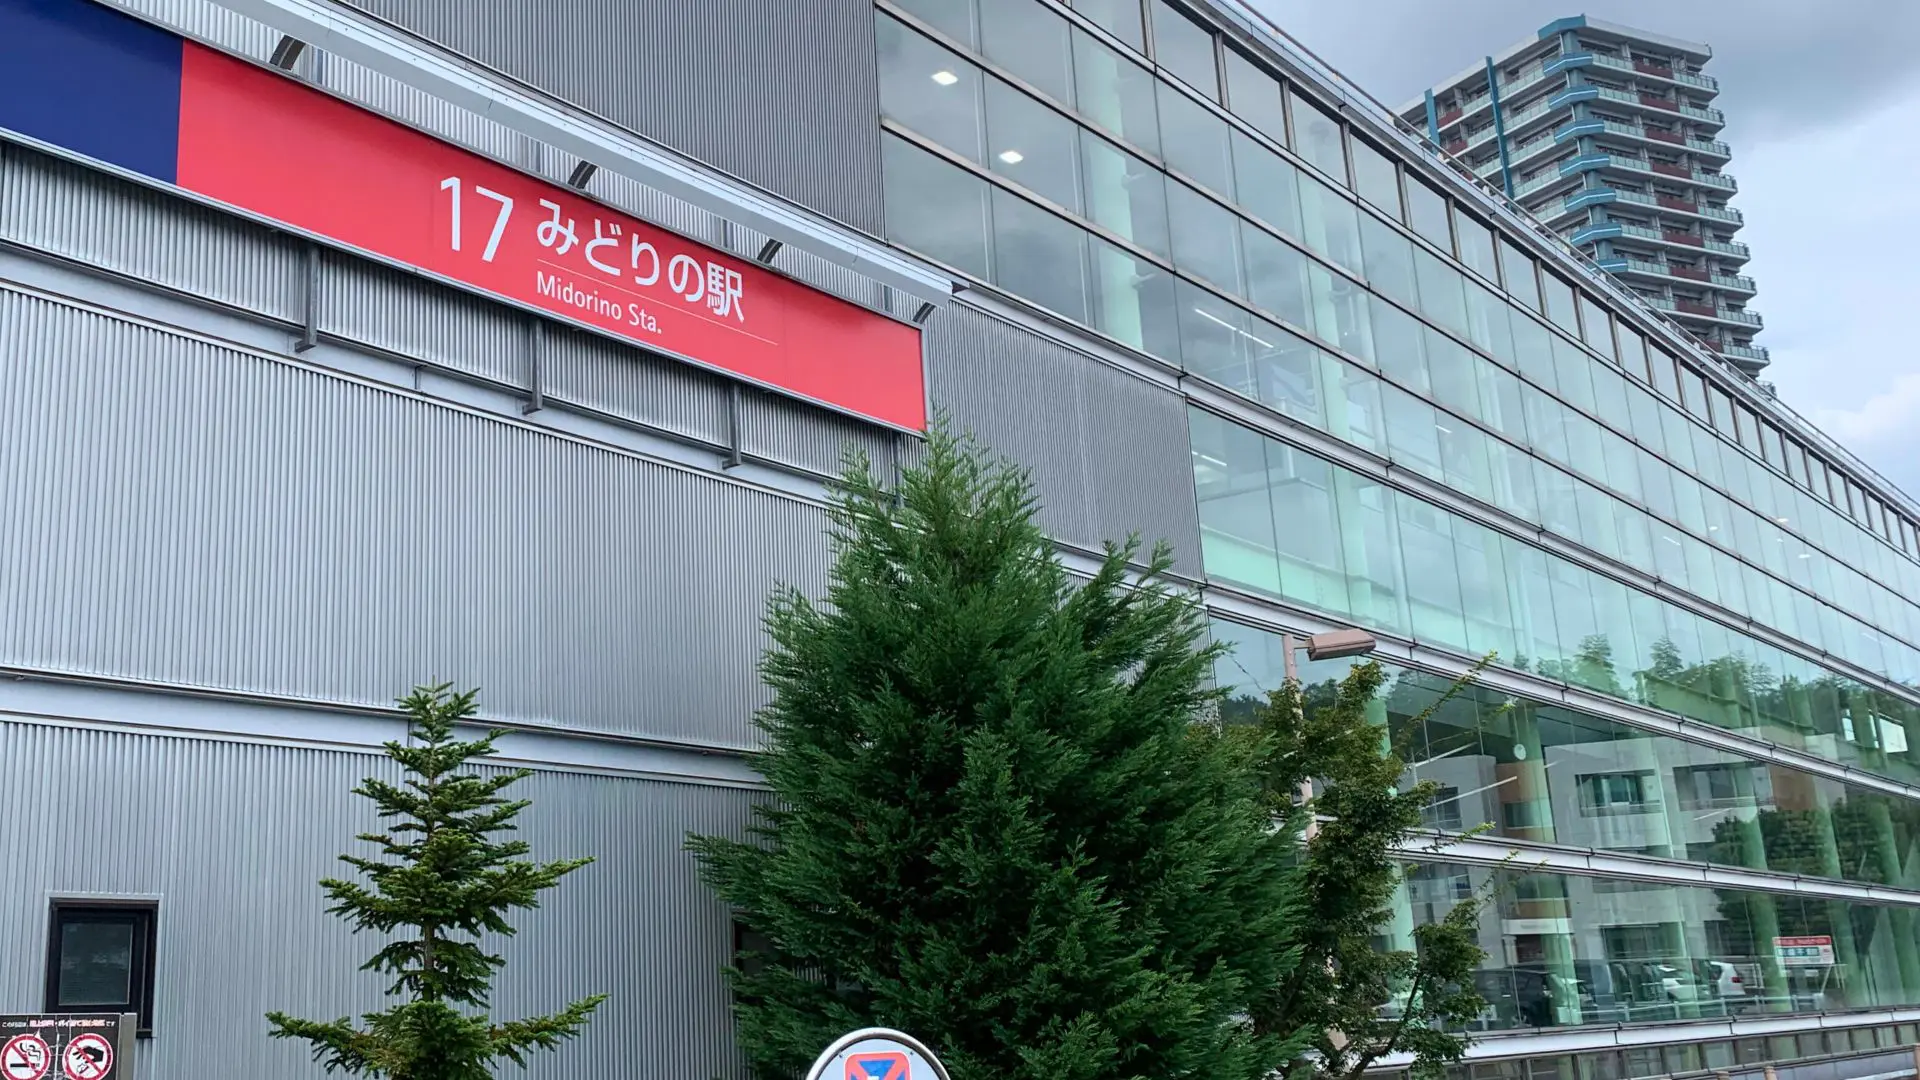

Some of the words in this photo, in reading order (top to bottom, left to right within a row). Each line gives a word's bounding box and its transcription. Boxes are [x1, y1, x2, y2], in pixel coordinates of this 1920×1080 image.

[440, 176, 514, 263] 17
[537, 198, 745, 323] みどりの駅
[536, 270, 622, 321] Midorino
[628, 303, 662, 334] Sta.
